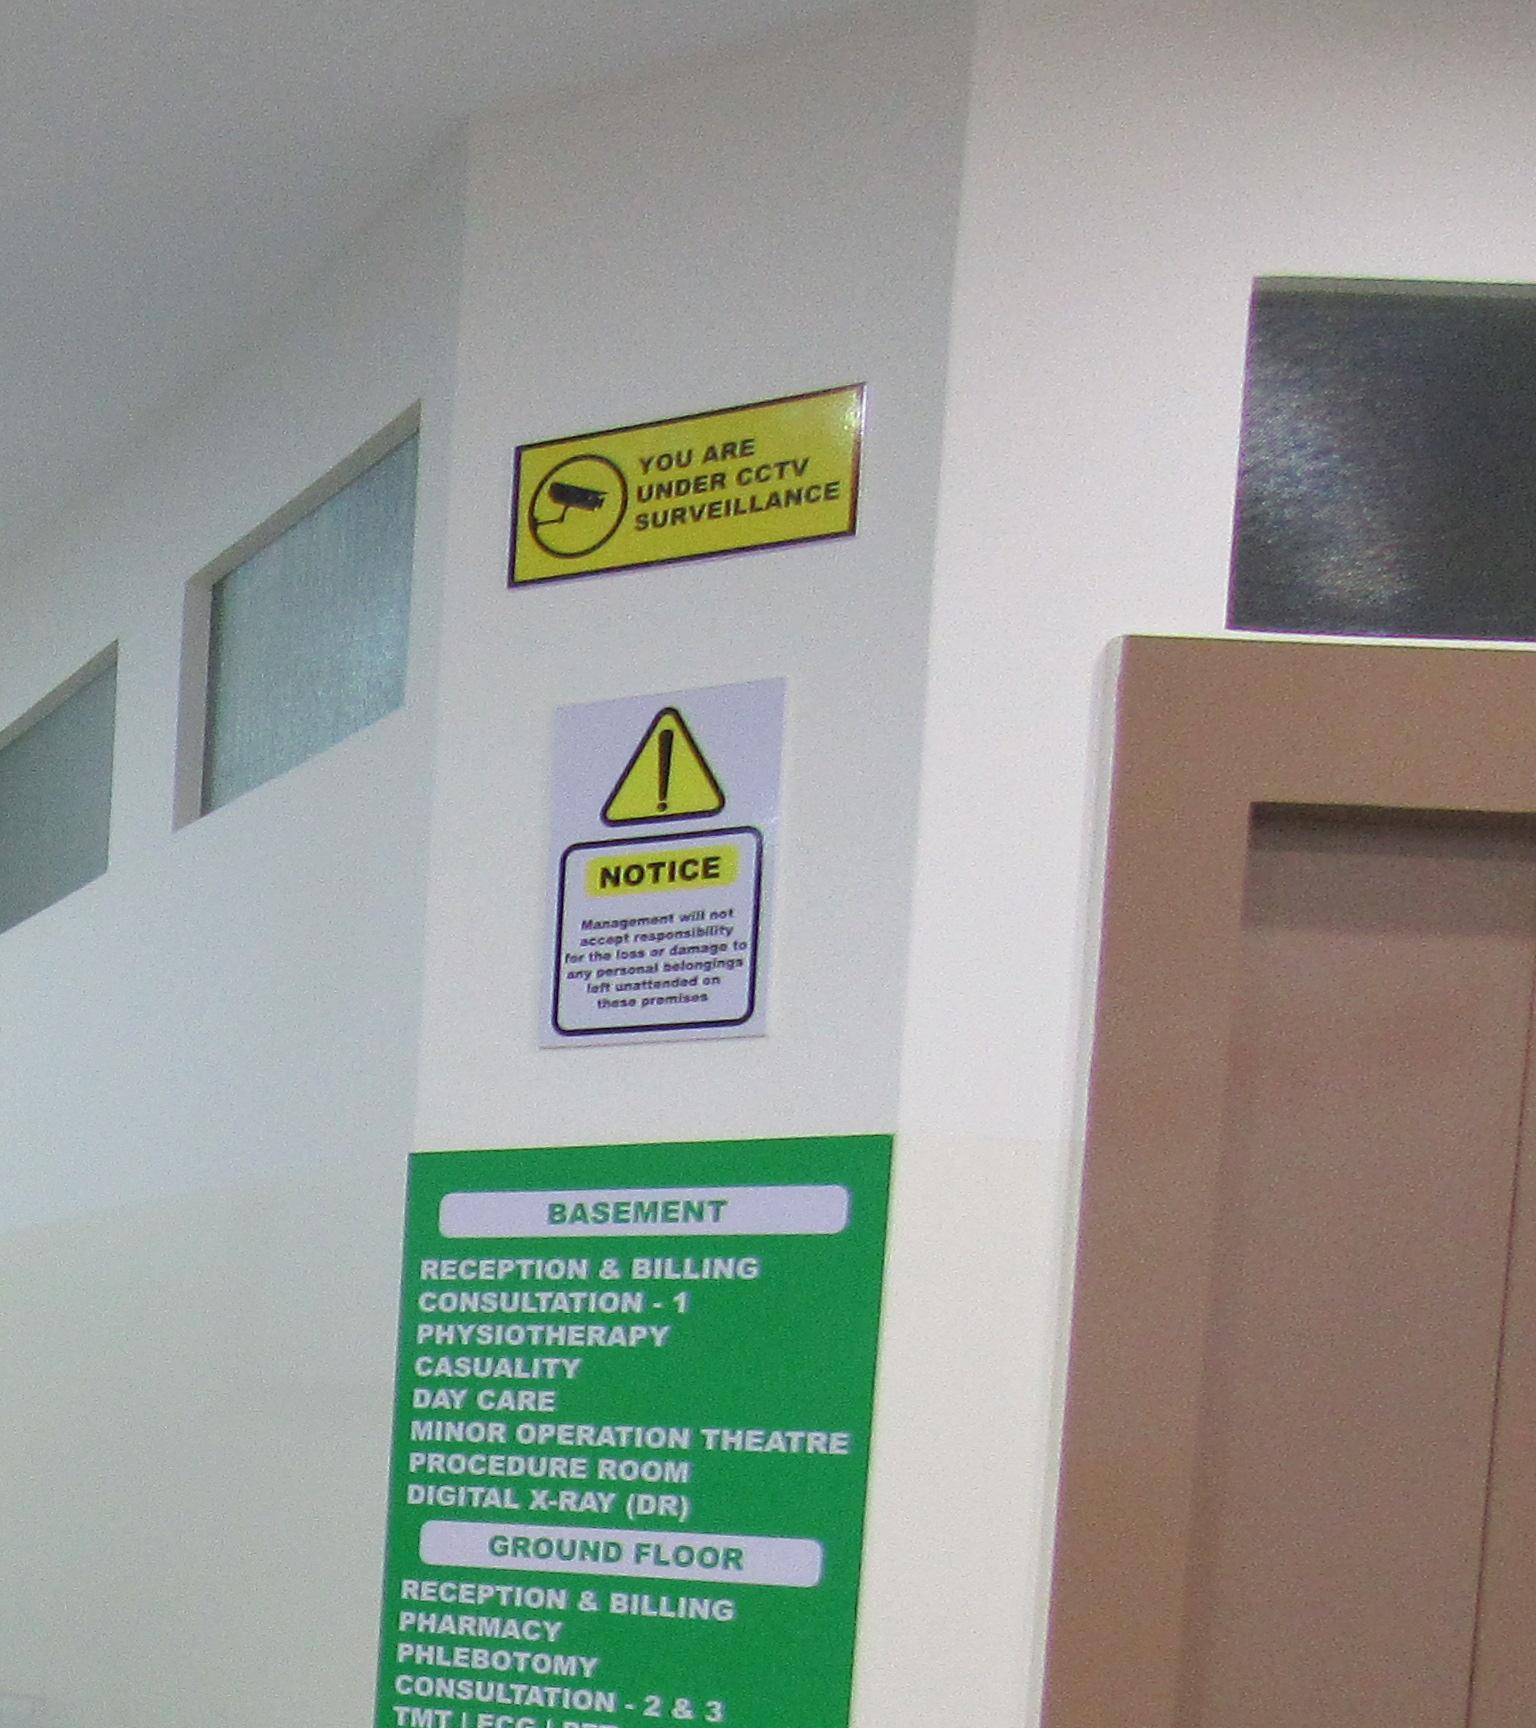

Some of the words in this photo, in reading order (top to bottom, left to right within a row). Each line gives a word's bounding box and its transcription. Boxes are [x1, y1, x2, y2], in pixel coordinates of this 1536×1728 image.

[640, 447, 694, 476] YOU
[703, 438, 756, 468] ARE
[636, 471, 727, 504] UNDER
[735, 458, 810, 487] CCTV
[634, 481, 841, 532] SURVEILLANCE
[599, 856, 721, 889] NOTICE
[581, 914, 674, 931] Management
[680, 910, 705, 923] will
[709, 908, 734, 920] not
[579, 933, 630, 948] accept
[634, 925, 734, 943] responsibility
[565, 951, 584, 964] for
[589, 949, 611, 962] the
[616, 947, 645, 960] loss
[649, 947, 664, 958] or
[669, 941, 727, 957] damage
[733, 940, 747, 951] to
[566, 968, 592, 981] any
[596, 963, 658, 979] personal
[663, 957, 743, 974] belongings
[586, 982, 610, 994] left
[615, 976, 697, 992] unattended
[702, 976, 721, 986] on
[597, 996, 636, 1009] these
[641, 992, 708, 1008] premises
[547, 1200, 728, 1226] BASEMENT
[420, 1259, 588, 1281] RECEPTION
[600, 1259, 620, 1279] &
[631, 1257, 760, 1280] BILLING
[418, 1292, 643, 1313] CONSULTATION
[672, 1292, 689, 1312] 1
[416, 1324, 669, 1348] PHYSIOTHERAPY
[414, 1356, 583, 1380] CASUALITY
[413, 1389, 468, 1410] DAY
[476, 1390, 556, 1412] CARE
[411, 1421, 507, 1444] MINOR
[515, 1424, 691, 1449] OPERATION
[701, 1429, 850, 1455] THEATRE
[409, 1453, 588, 1480] PROCEDURE
[598, 1459, 691, 1483] ROOM
[407, 1485, 520, 1510] DIGITAL
[528, 1489, 615, 1515] X-RAY
[627, 1493, 691, 1522] (DR)
[488, 1535, 623, 1563] GROUND
[634, 1542, 745, 1571] FLOOR
[401, 1580, 567, 1610] RECEPTION
[579, 1590, 600, 1612] &
[610, 1593, 735, 1622] BILLING
[398, 1612, 563, 1642] PHARMACY
[397, 1643, 600, 1679] PHLEBOTOMY
[395, 1675, 618, 1713] CONSULTATION
[644, 1696, 662, 1718] 2
[671, 1698, 695, 1720] &
[705, 1700, 726, 1723] 3
